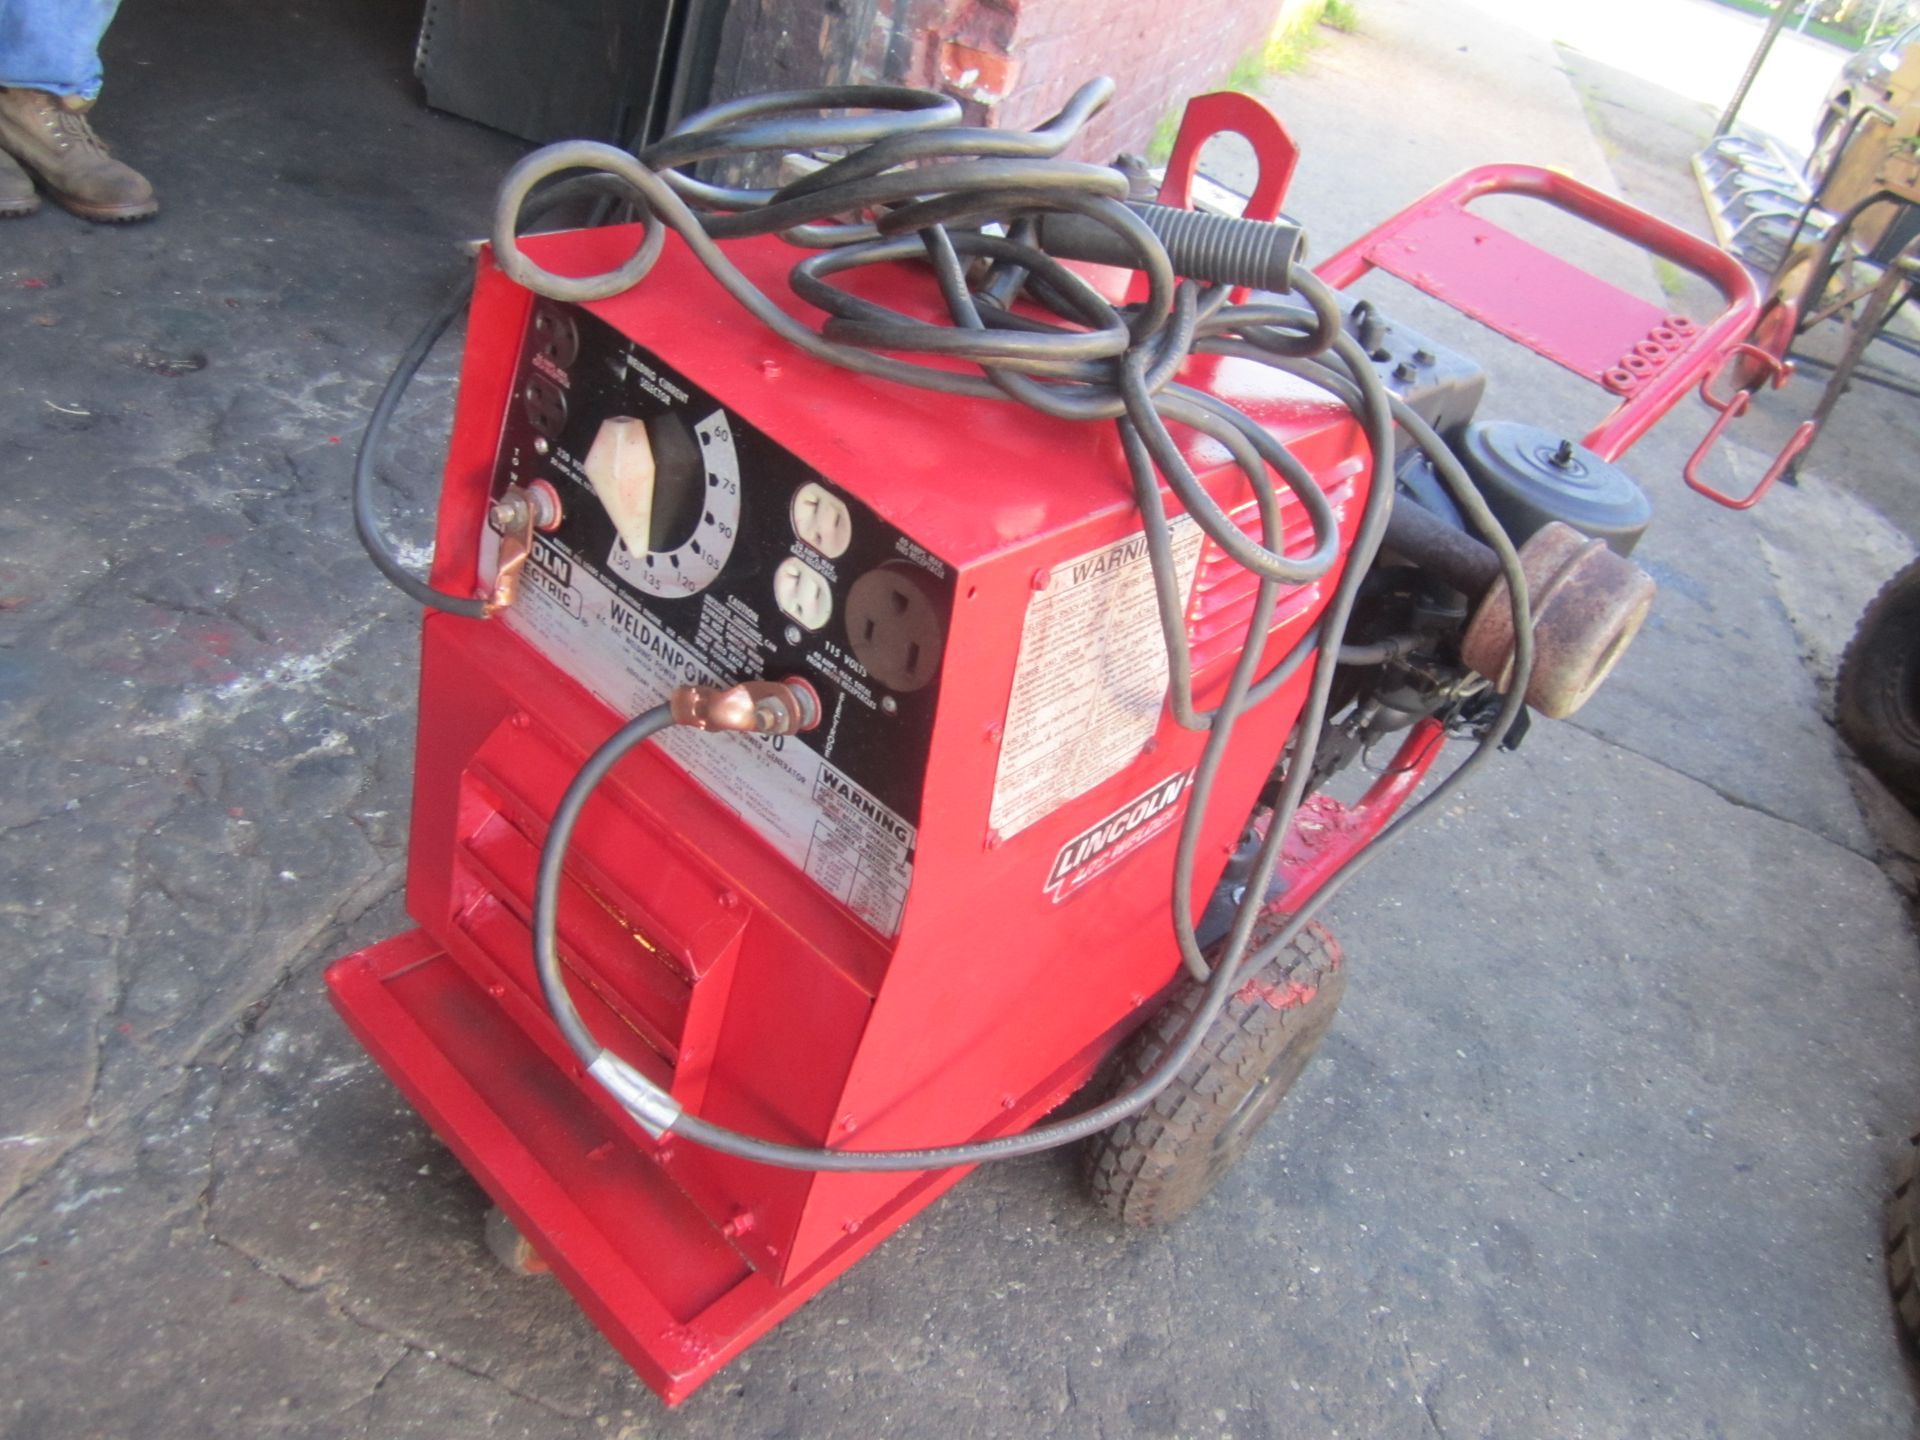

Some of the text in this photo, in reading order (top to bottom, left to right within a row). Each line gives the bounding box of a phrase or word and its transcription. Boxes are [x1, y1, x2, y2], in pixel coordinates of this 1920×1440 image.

[714, 425, 729, 442] 60
[722, 478, 737, 495] 75
[718, 521, 733, 539] 90
[613, 551, 630, 571] 150
[700, 551, 720, 571] 105
[643, 570, 661, 590] 135
[676, 571, 696, 592] 120
[727, 595, 759, 622] CAUTION
[610, 599, 724, 691] WELDANPOW
[825, 640, 867, 677] 115 VOLTS
[766, 750, 806, 783] GENERATOR
[823, 768, 908, 843] WARNING
[1055, 775, 1175, 878] LINCOLN
